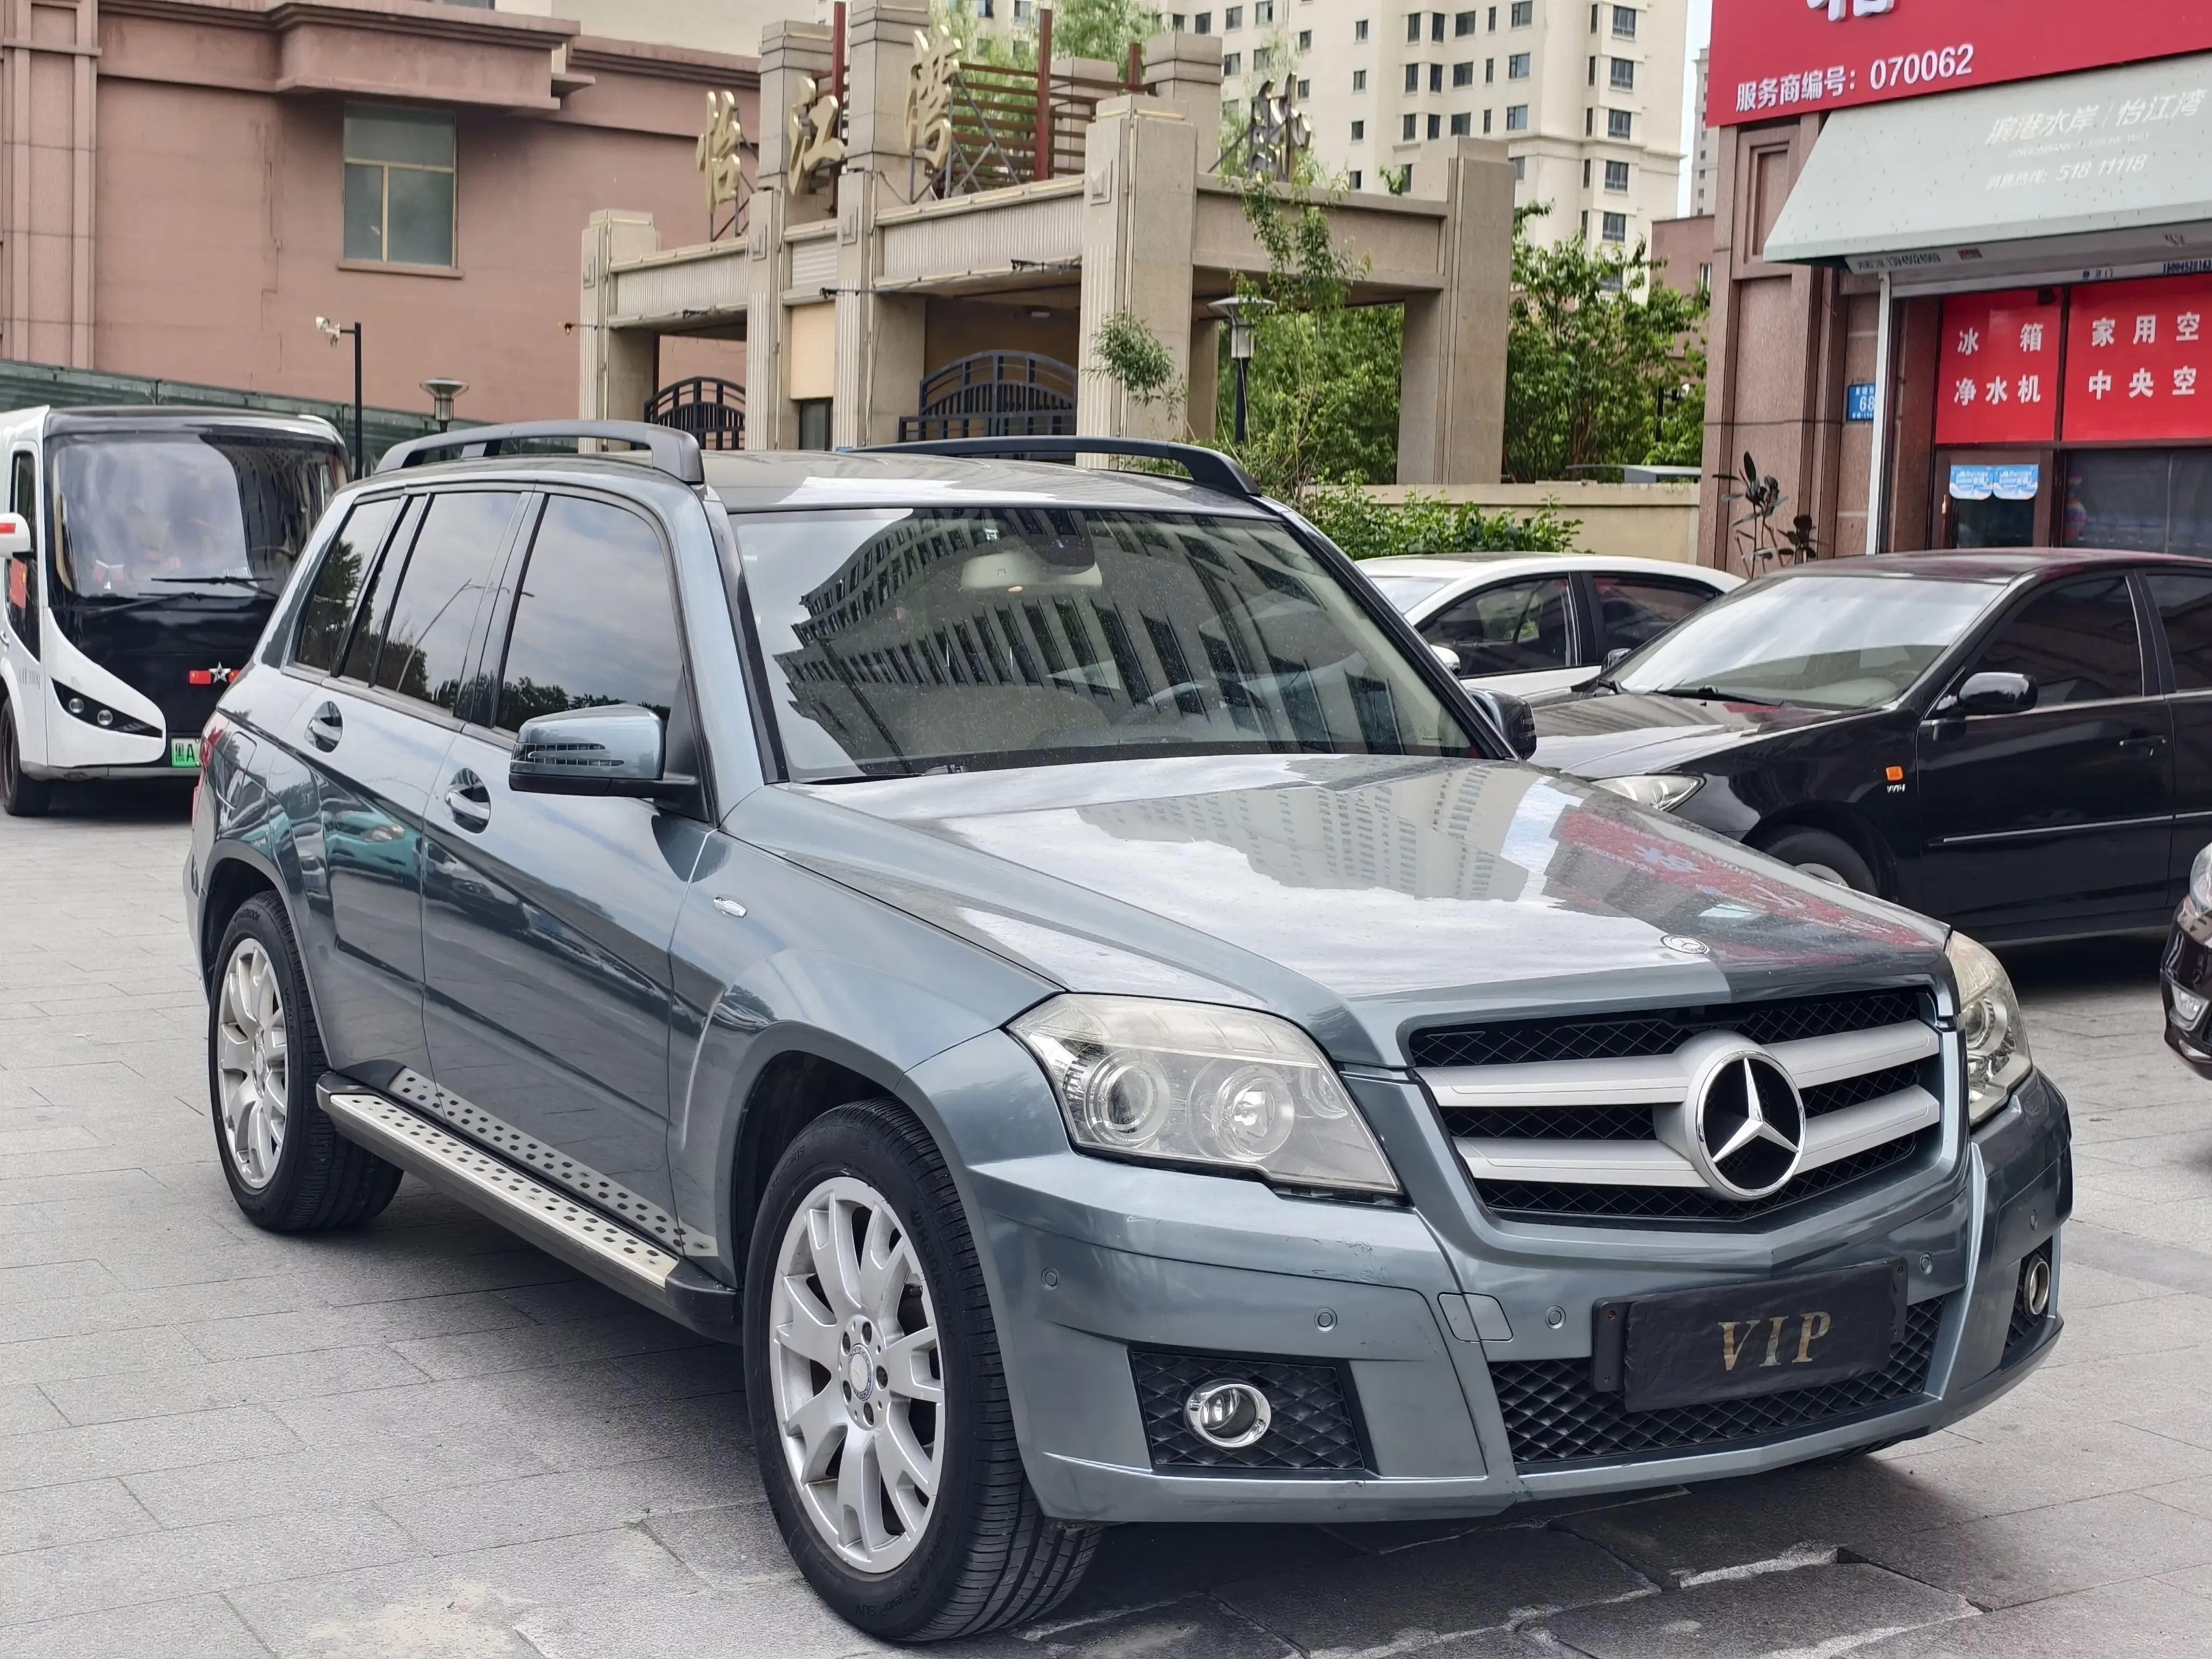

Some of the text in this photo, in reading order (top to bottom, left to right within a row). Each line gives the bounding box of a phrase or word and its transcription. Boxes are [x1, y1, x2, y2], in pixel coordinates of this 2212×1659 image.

[1736, 43, 1974, 112] 服务商编号： 070062
[2055, 161, 2092, 182] 518
[1958, 322, 2044, 356] 冰箱
[2092, 312, 2201, 347] 家用空
[1954, 374, 2041, 406] 净水机
[2088, 366, 2197, 401] 中央空
[1718, 1311, 1831, 1371] VIP
